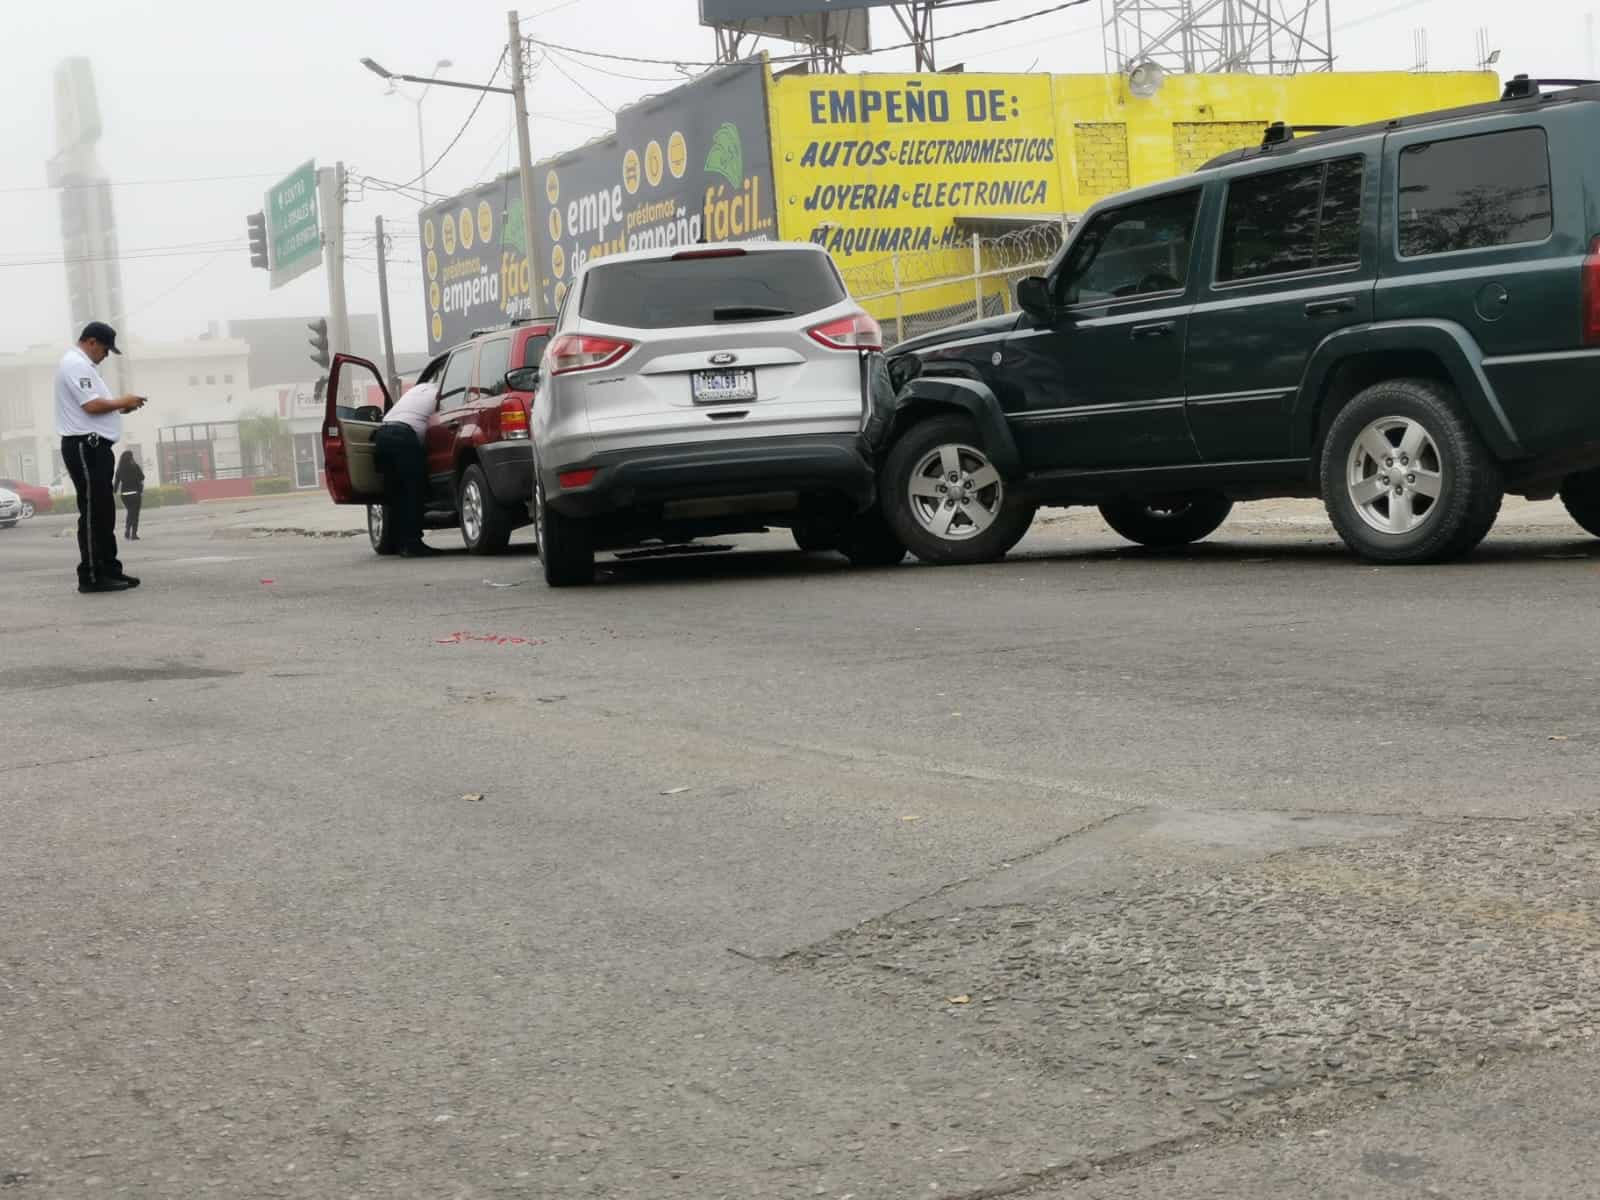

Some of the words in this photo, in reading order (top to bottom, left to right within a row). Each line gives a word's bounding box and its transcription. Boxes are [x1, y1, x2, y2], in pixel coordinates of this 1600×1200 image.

[809, 80, 949, 124] EMPEÑO
[966, 89, 1019, 121] DE:
[800, 140, 891, 168] AUTOS
[900, 138, 1055, 165] ELECTRODOMESTICOS
[804, 183, 900, 211] JOYERIA
[911, 180, 1047, 208] ELECTRONICA
[809, 225, 932, 256] MAQUINARIA
[443, 264, 498, 317] empeña
